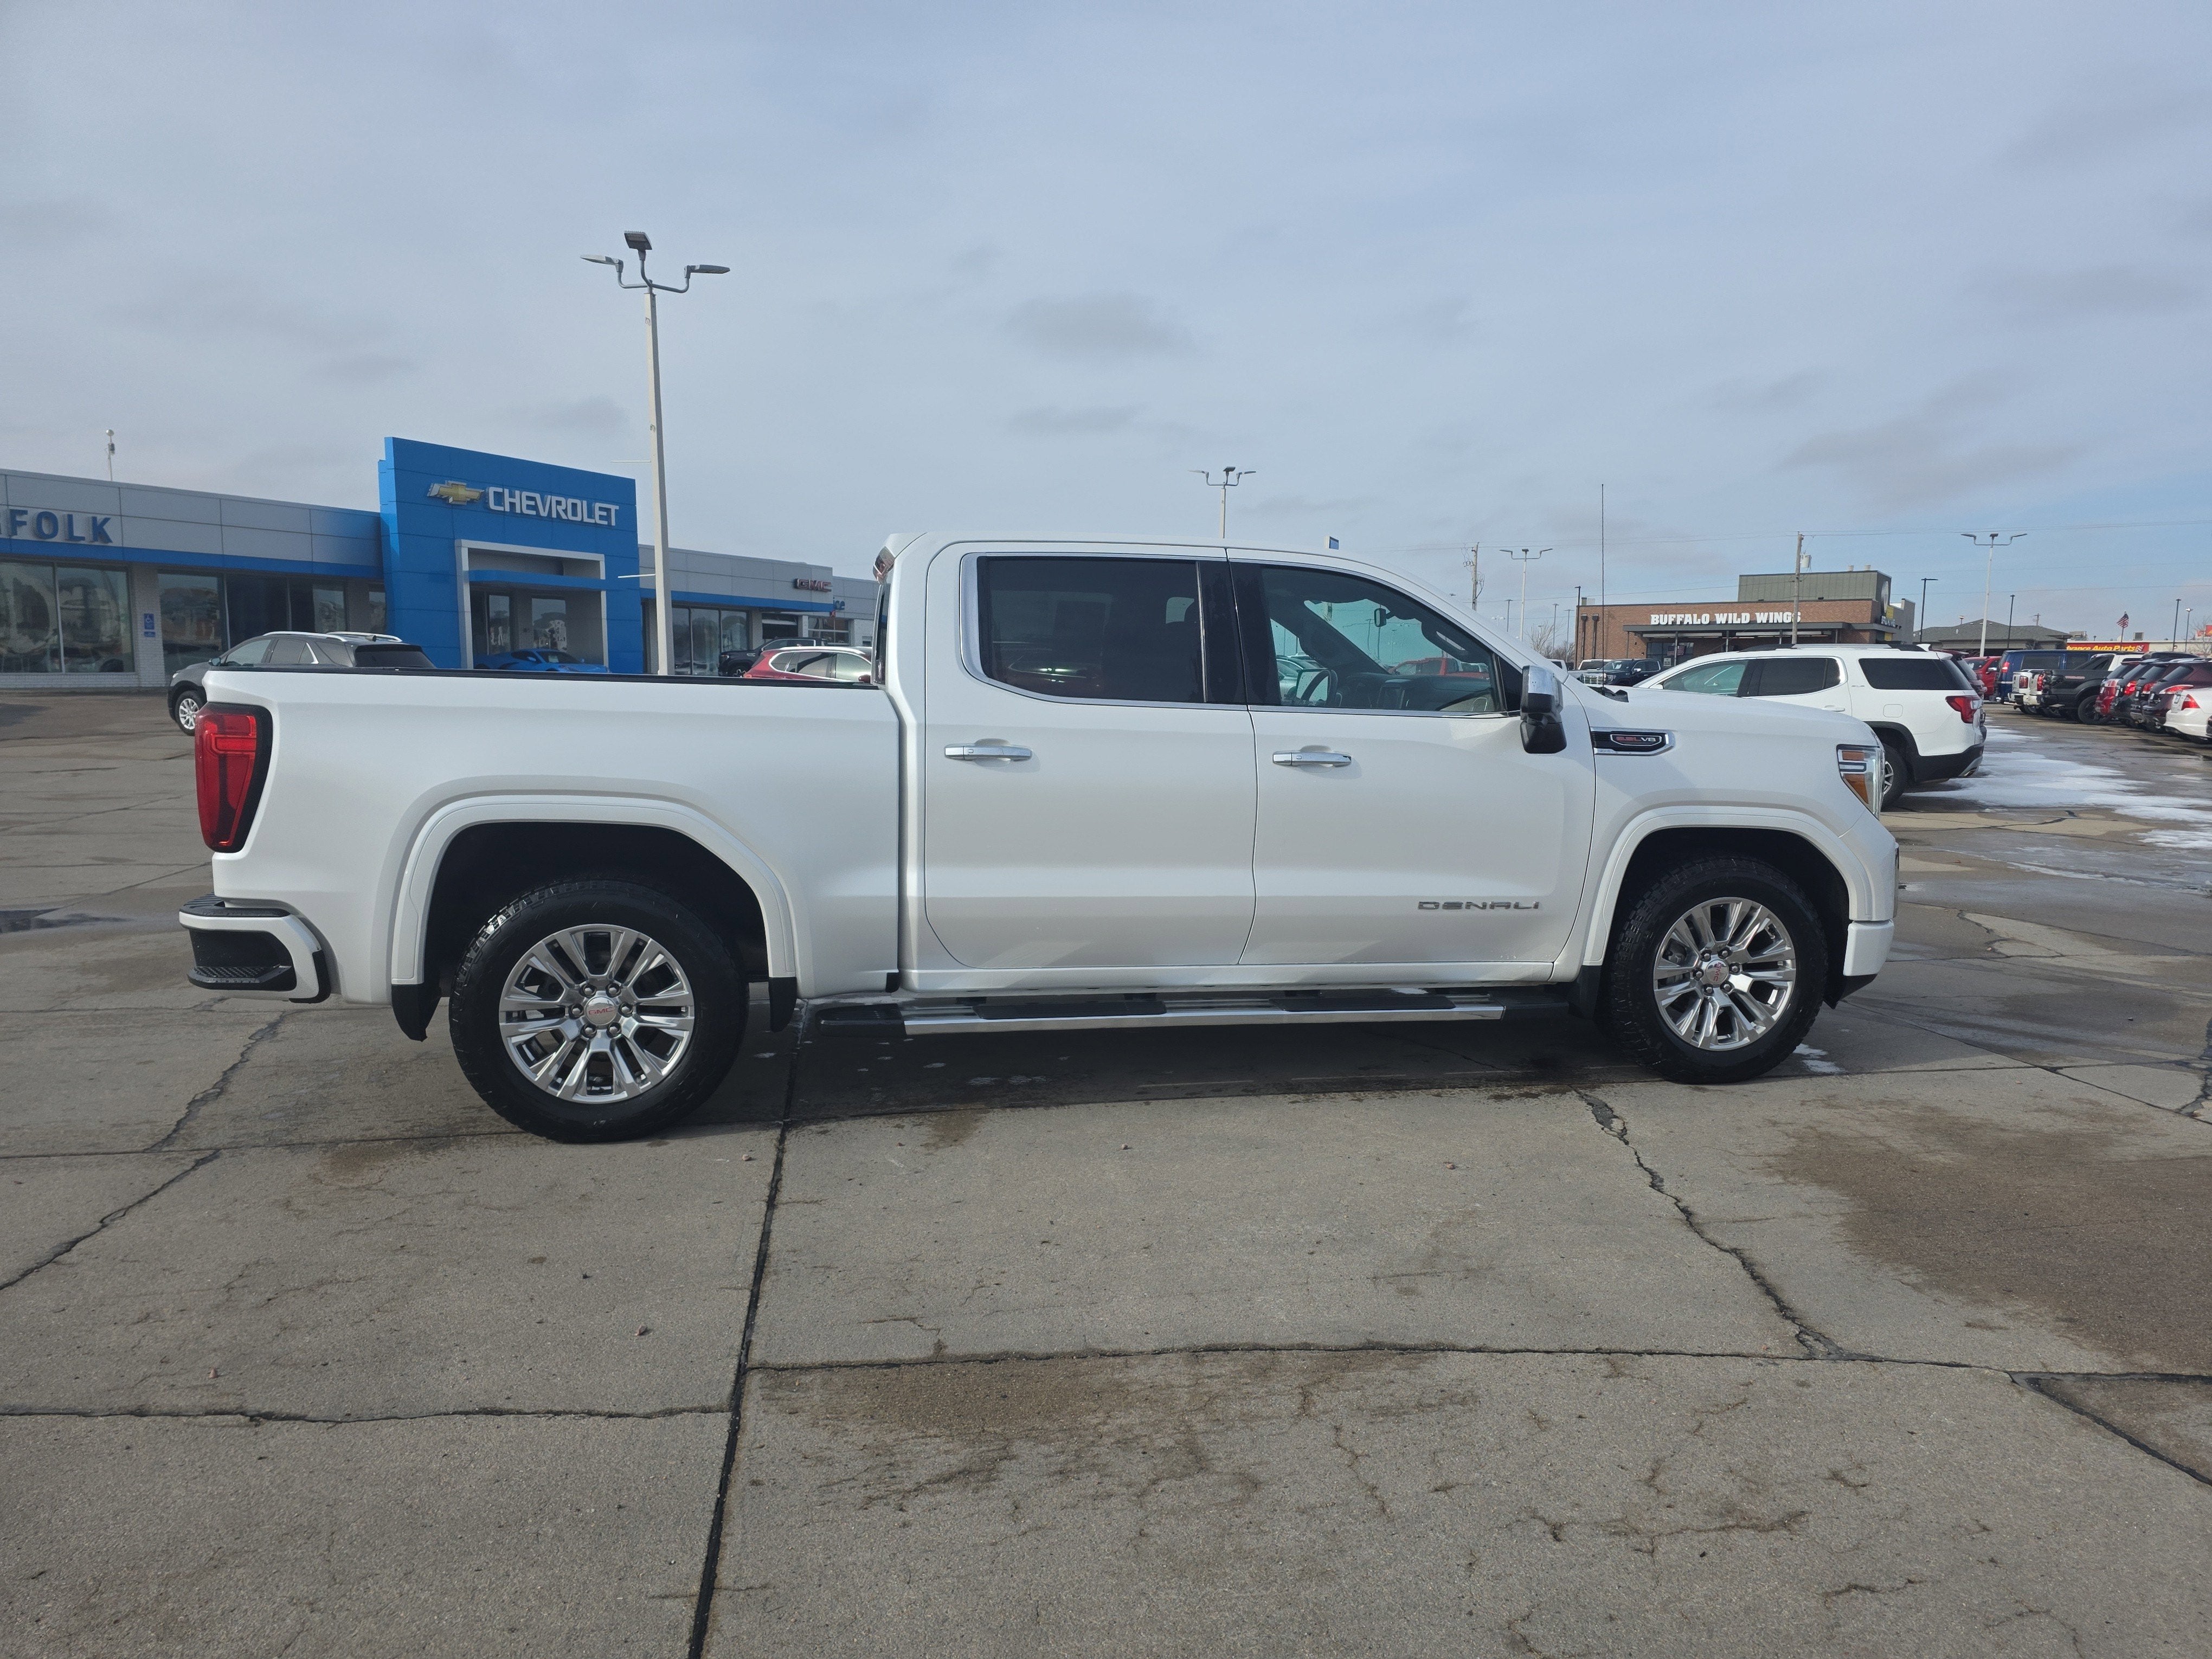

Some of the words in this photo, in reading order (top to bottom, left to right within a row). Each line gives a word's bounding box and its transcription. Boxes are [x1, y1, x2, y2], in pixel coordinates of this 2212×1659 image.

[488, 486, 619, 526] CHEVROLET
[0, 509, 113, 543] FOLK
[794, 578, 832, 592] GMC
[1650, 614, 1710, 625] BUFFALO
[1714, 613, 1750, 624] WILD
[1418, 901, 1539, 910] DENALI
[1713, 962, 1722, 981] GMC
[588, 1006, 614, 1015] GMC
